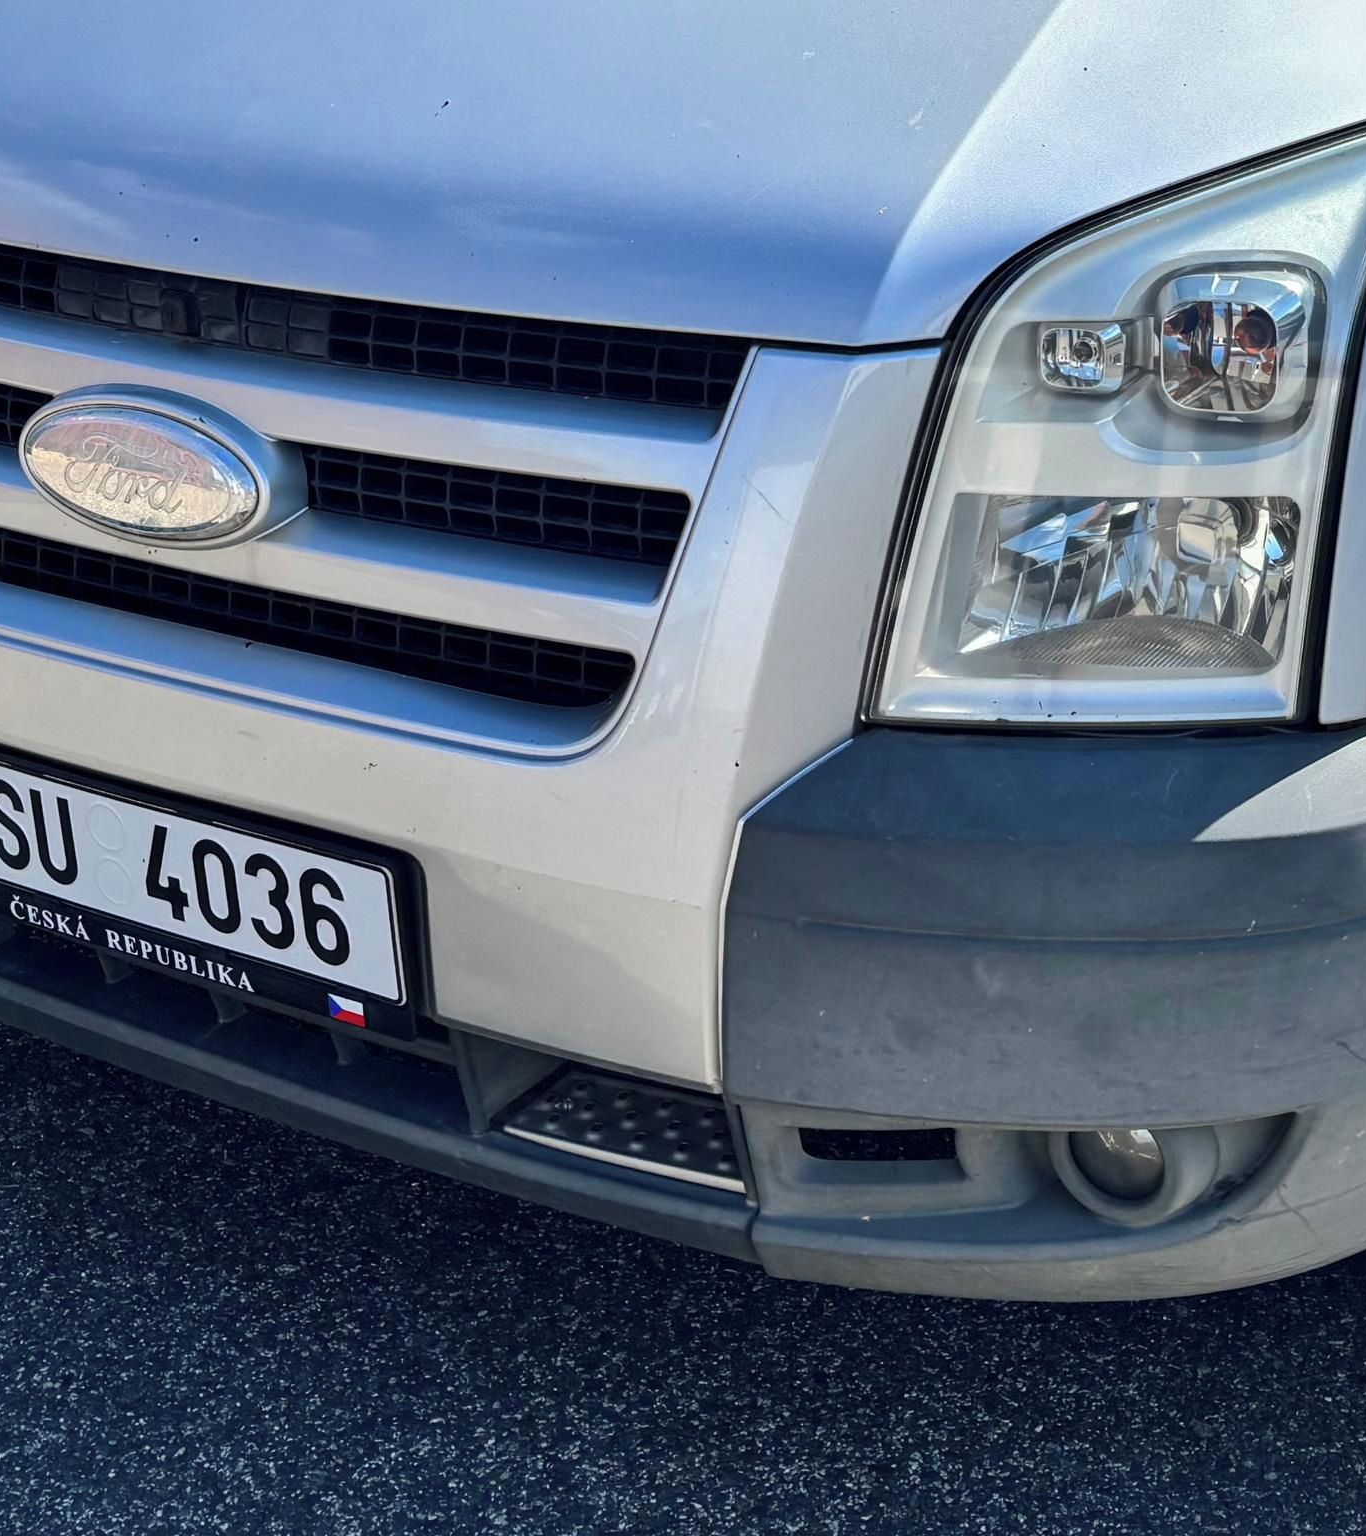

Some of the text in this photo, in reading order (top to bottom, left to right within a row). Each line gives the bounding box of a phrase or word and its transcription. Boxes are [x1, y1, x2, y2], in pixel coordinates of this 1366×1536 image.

[64, 431, 189, 513] Ford
[10, 895, 255, 993] ČESKÁ REPUBLIKA
[145, 825, 350, 966] 4036
